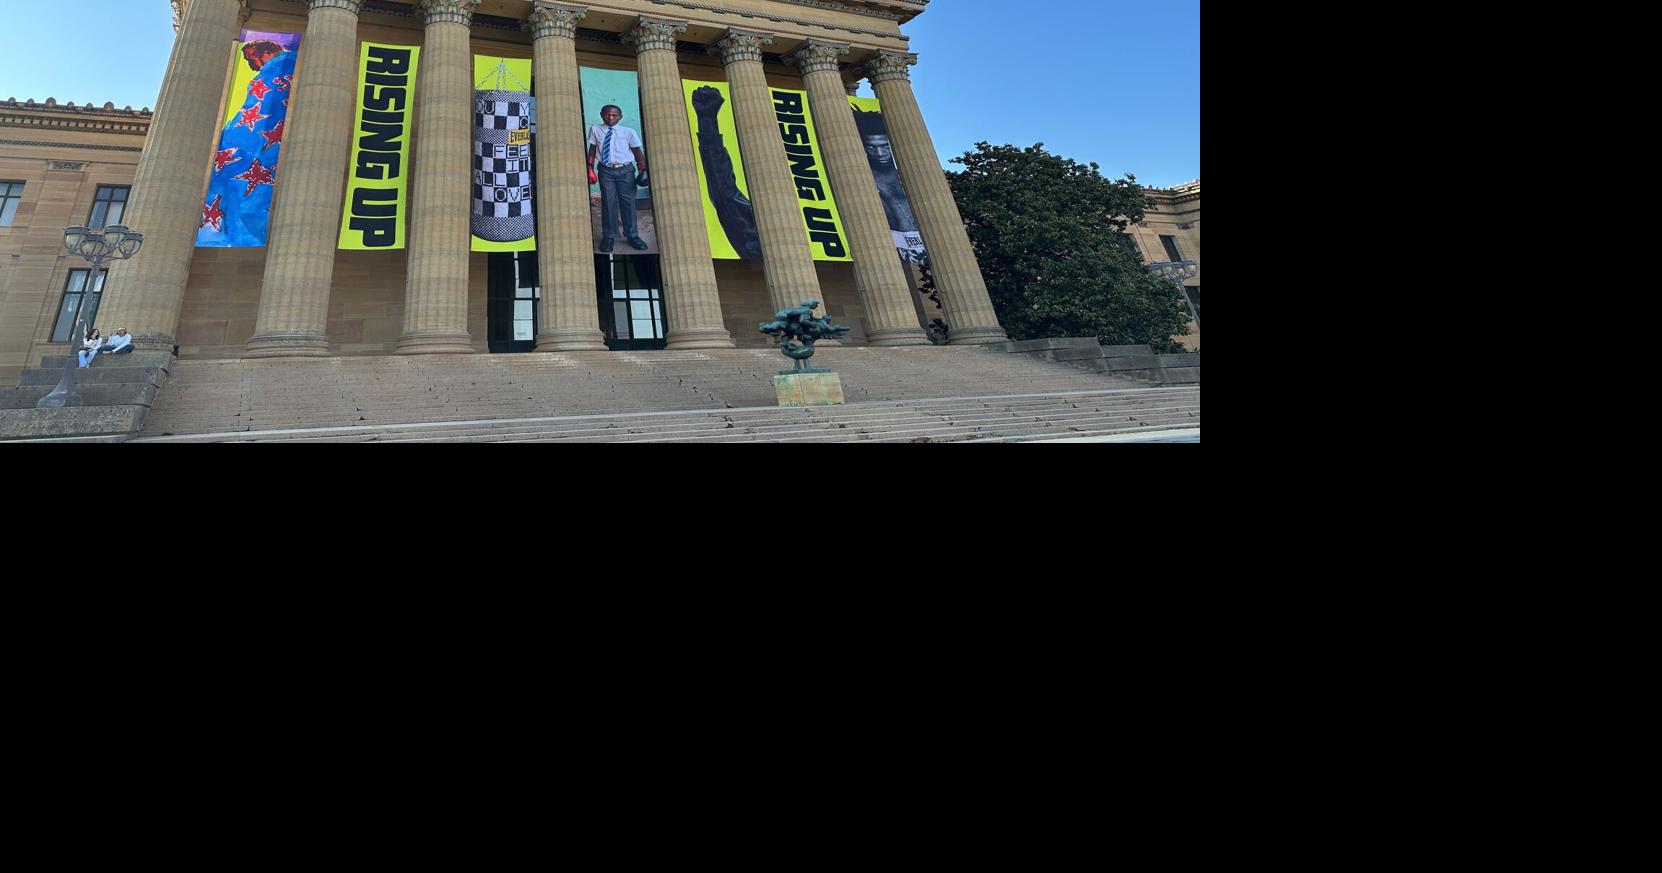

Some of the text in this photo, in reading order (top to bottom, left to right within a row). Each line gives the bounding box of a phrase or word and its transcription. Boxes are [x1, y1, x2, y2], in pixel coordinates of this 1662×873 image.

[349, 46, 411, 247] RISING UP
[494, 144, 530, 158] FEE
[475, 170, 506, 187] ALL
[772, 90, 846, 258] RISING UP
[495, 186, 532, 202] OVE
